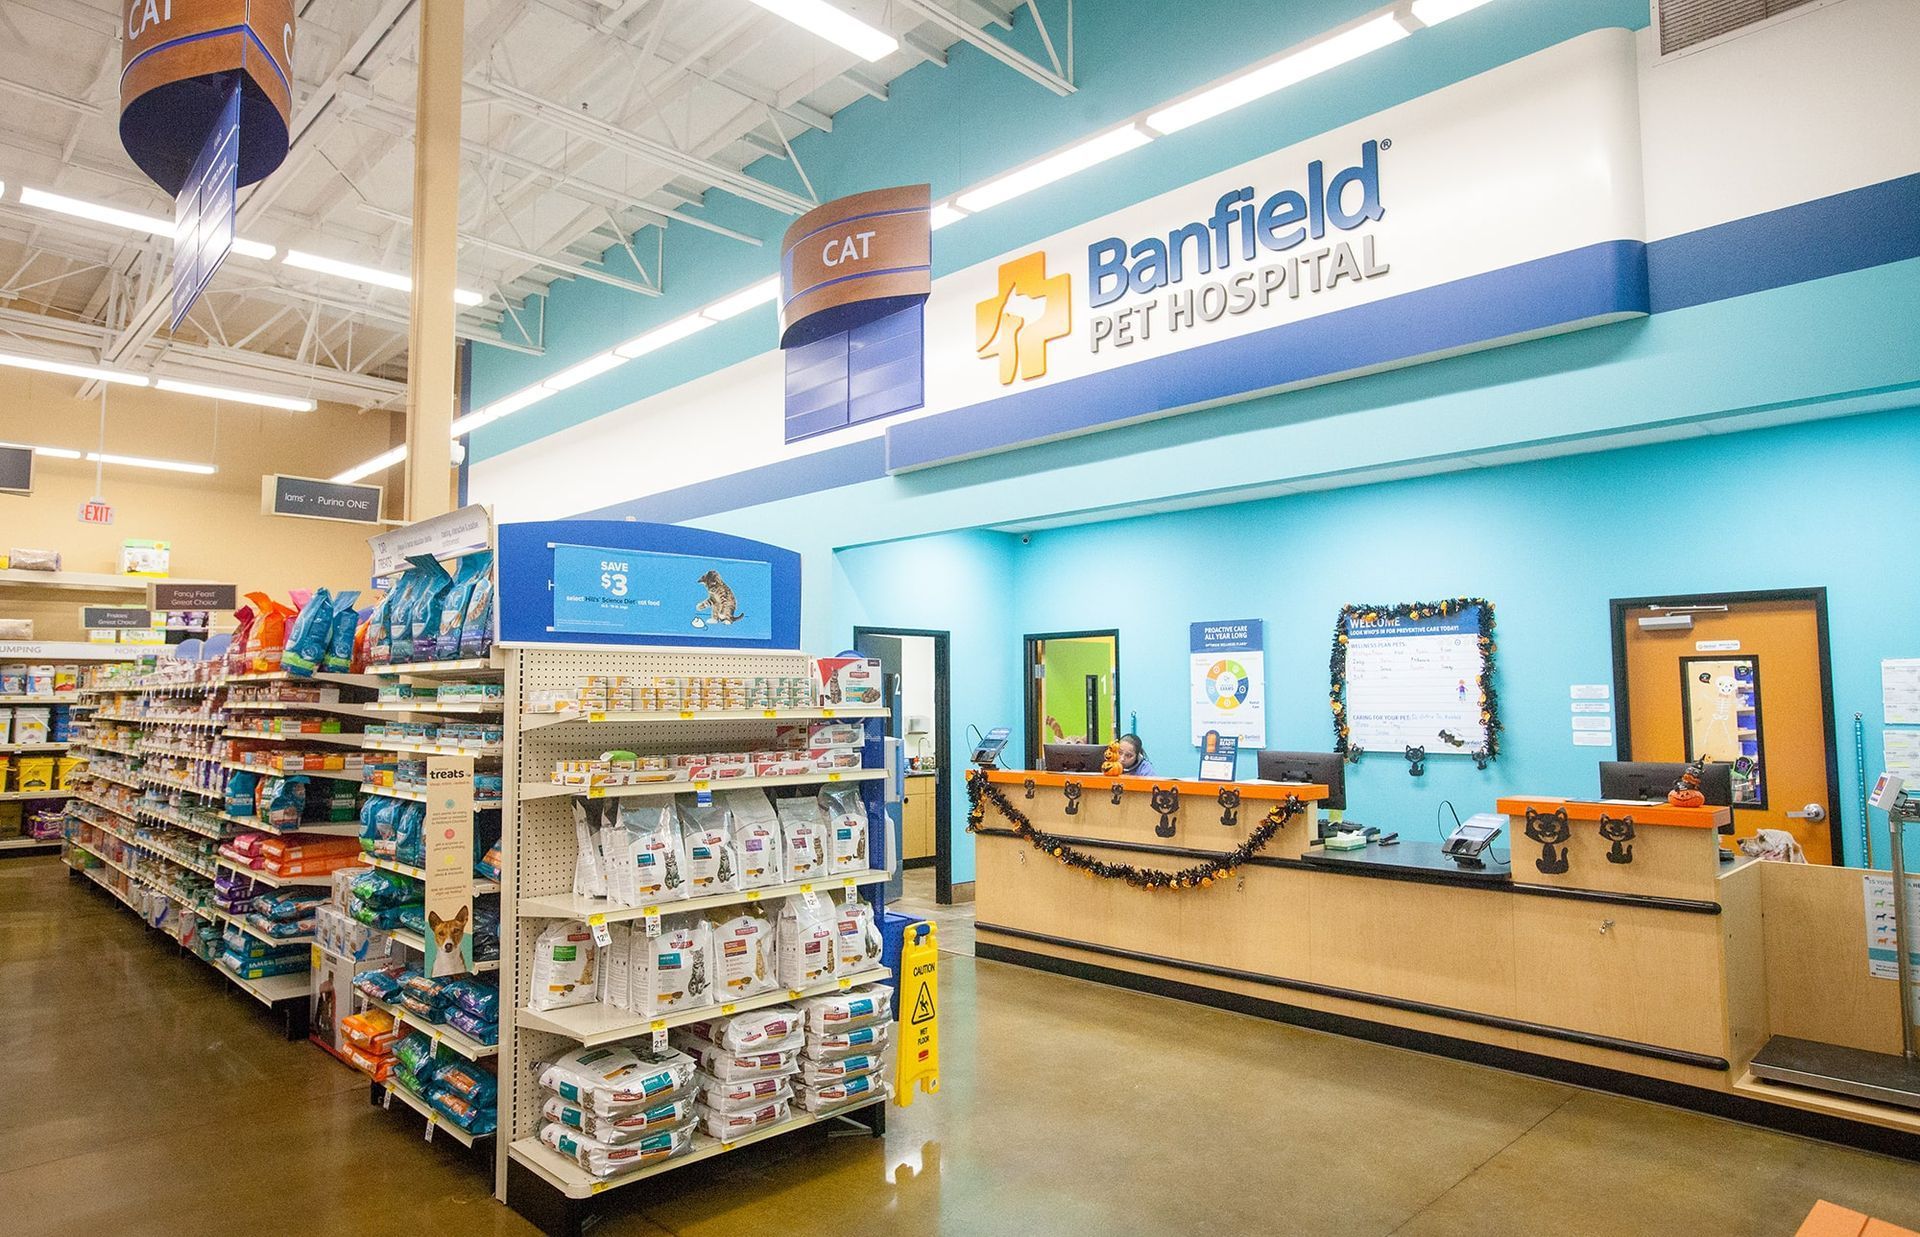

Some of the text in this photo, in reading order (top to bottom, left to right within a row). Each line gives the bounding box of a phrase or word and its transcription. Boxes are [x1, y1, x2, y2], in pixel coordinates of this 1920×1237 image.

[822, 231, 876, 267] CAT
[1089, 234, 1390, 353] PET HOSPITAL
[317, 496, 345, 507] Purina
[346, 499, 369, 510] ONE
[84, 504, 112, 523] EXIT
[601, 560, 628, 572] SAVE
[601, 572, 628, 596] $3
[173, 590, 215, 599] Fancy Feast
[601, 596, 623, 604] Science
[894, 672, 901, 696] 2
[429, 769, 465, 780] treats
[913, 962, 936, 977] CAUTION
[919, 1027, 928, 1036] WET
[917, 1035, 930, 1046] FLOOR
